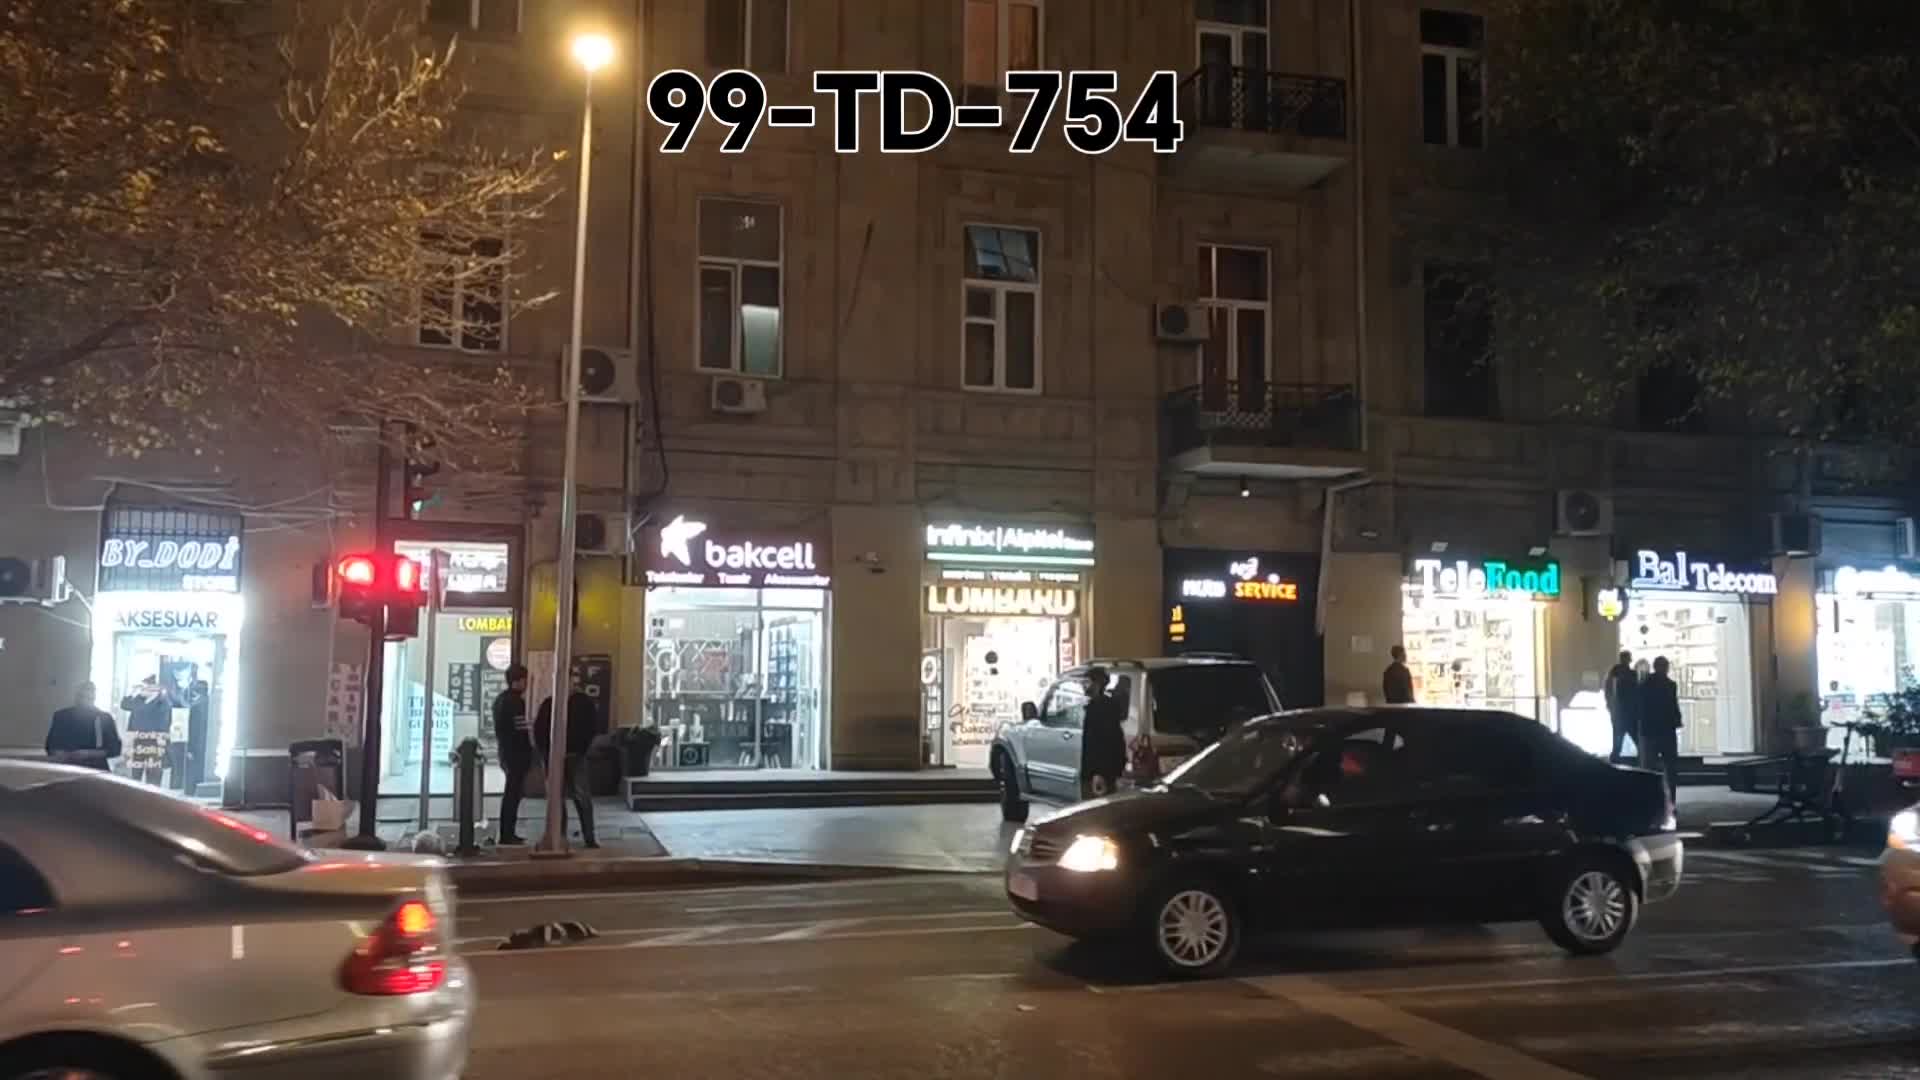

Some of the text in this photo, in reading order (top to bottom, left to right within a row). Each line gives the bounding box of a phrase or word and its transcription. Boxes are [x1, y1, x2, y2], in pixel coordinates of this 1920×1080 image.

[705, 540, 815, 569] bakcell
[1415, 559, 1560, 594] TeleFood
[1638, 551, 1777, 593] Bal Telecom
[928, 585, 1075, 615] LOMBARD
[114, 610, 218, 628] AKSESUAR
